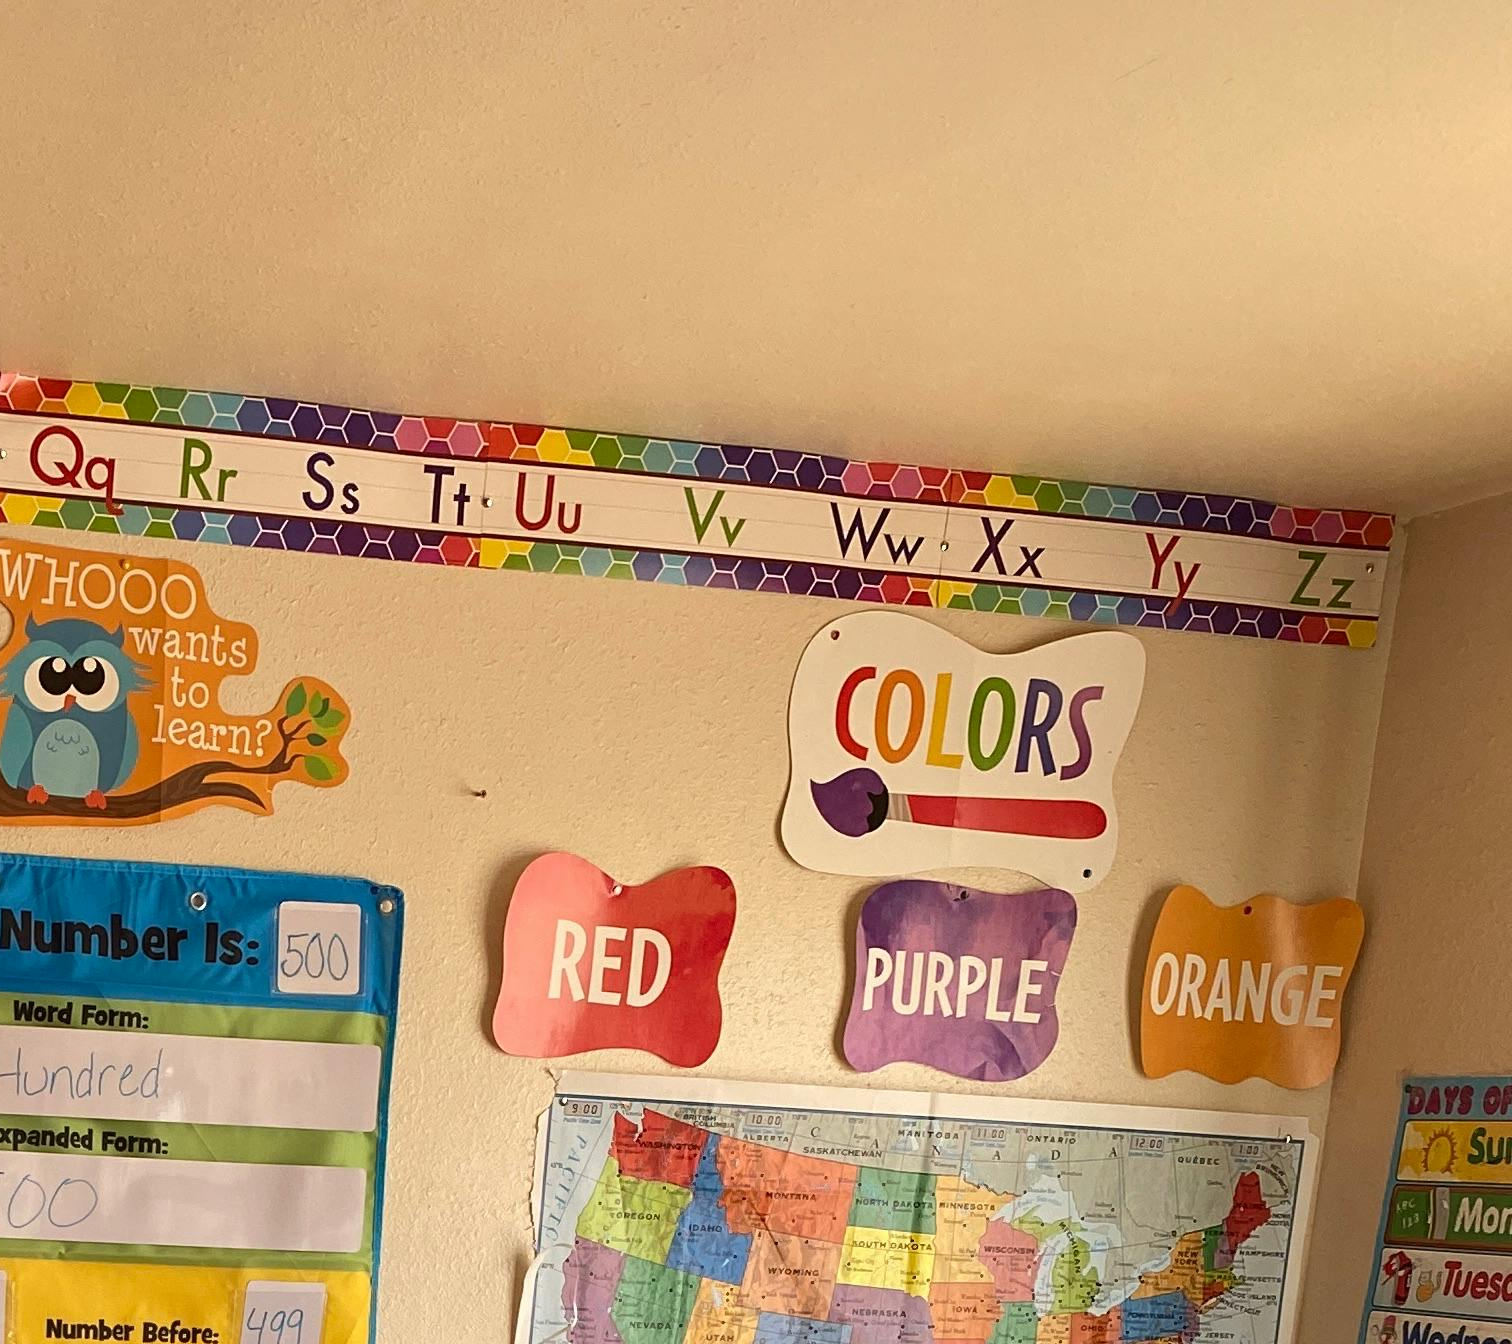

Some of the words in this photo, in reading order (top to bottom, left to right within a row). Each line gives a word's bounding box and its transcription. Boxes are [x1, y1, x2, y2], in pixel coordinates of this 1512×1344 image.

[30, 426, 124, 516] Qq
[180, 438, 238, 502] Rr
[302, 452, 360, 515] Ss
[424, 464, 470, 526] Tt
[515, 472, 581, 534] Uu
[683, 487, 745, 548] Vv
[830, 502, 924, 565] Ww
[971, 517, 1045, 578] Xx
[1145, 532, 1200, 616] Yy
[1289, 551, 1355, 609] Zz
[129, 624, 248, 668] wants
[171, 667, 210, 708] to
[151, 704, 273, 757] learn?
[835, 666, 1104, 781] COLORS
[0, 907, 188, 961] Number
[205, 922, 260, 966] Is:
[281, 933, 349, 981] 500
[548, 920, 672, 1008] RED
[862, 947, 1048, 1024] PURPLE
[1149, 952, 1343, 1029] ORANGE
[13, 1000, 73, 1025] Word
[81, 1004, 149, 1030] Form:
[1407, 1085, 1474, 1115] DAYS
[101, 1131, 169, 1155] Form:
[854, 1198, 889, 1208] NORTH
[892, 1200, 934, 1209] DAKOTA
[688, 1224, 724, 1233] IDAHO
[851, 1240, 887, 1249] SOUTH
[889, 1242, 933, 1250] DAKOTA
[983, 1246, 1036, 1254] WISCONSIN
[629, 1321, 673, 1330] NEVADA
[851, 1308, 907, 1318] NEBRASKA
[46, 1319, 134, 1342] Number
[142, 1320, 219, 1344] Before:
[705, 1334, 735, 1342] UTAH
